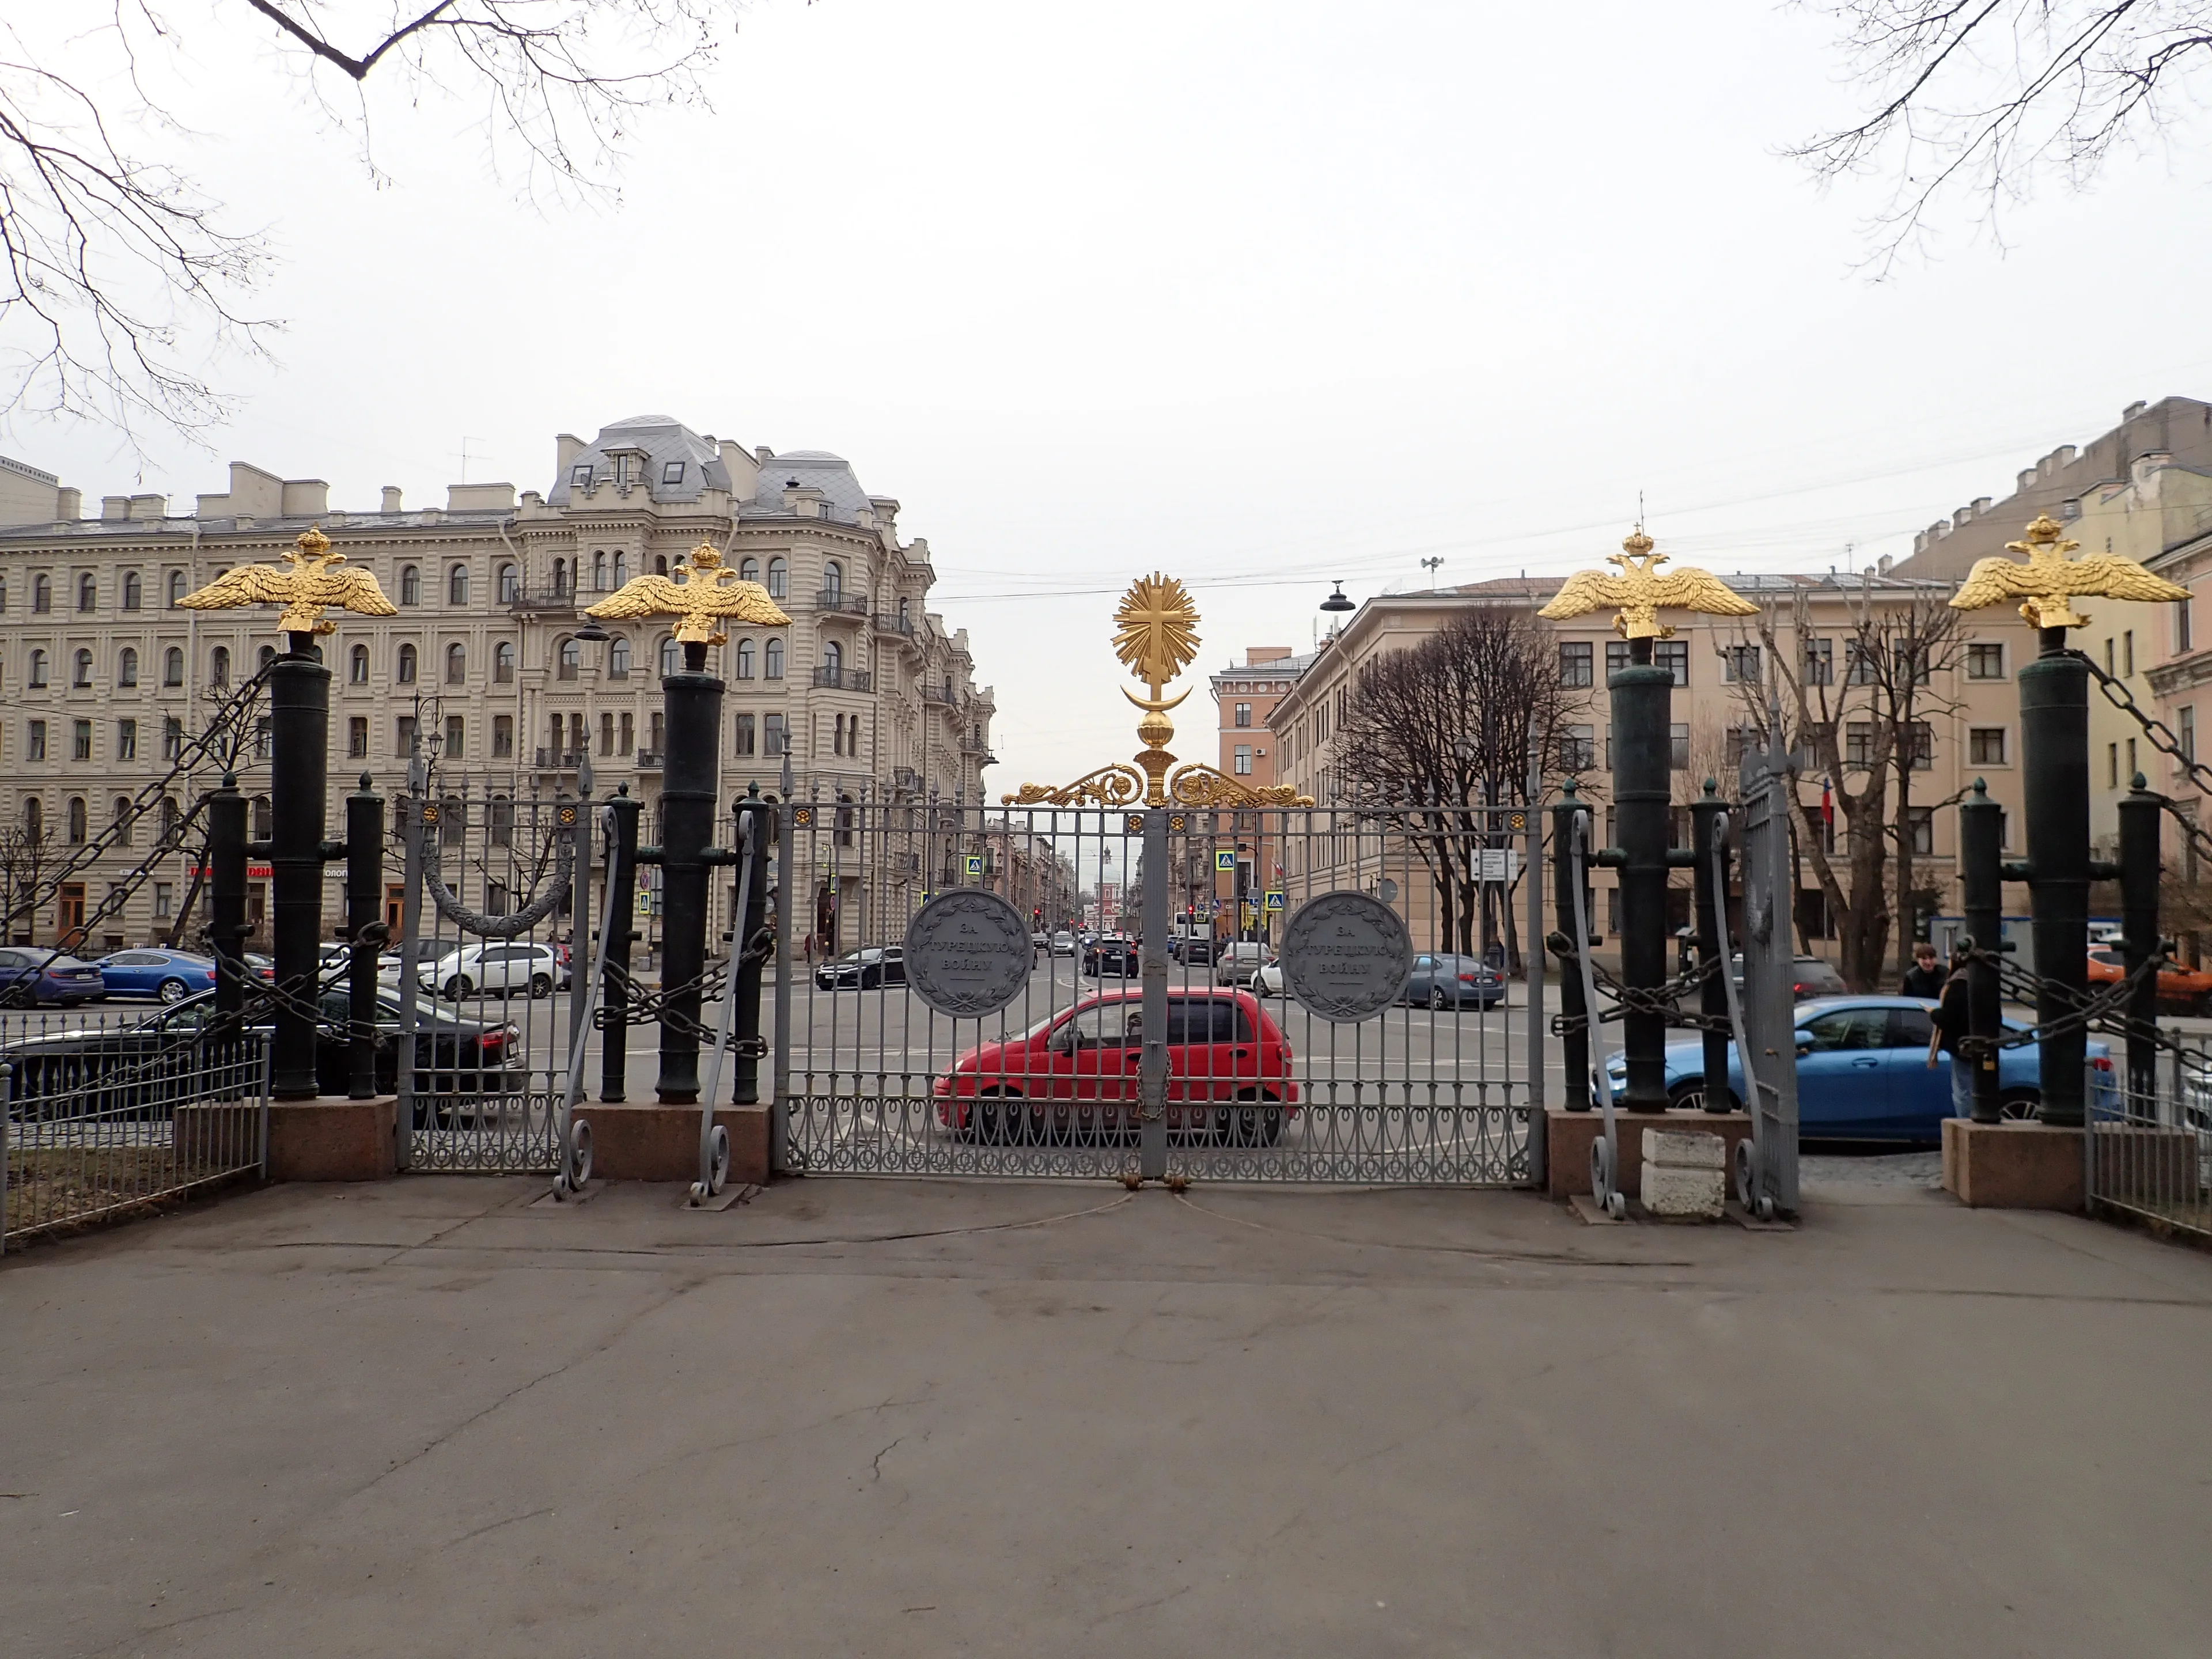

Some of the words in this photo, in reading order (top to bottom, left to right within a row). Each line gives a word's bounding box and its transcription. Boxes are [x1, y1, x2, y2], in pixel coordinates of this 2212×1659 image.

[959, 923, 979, 934] ЗА
[1336, 926, 1355, 937] ЗА
[929, 941, 1009, 954] ТУРЕЦКУЮ
[1305, 945, 1388, 957] ТУРЕЦКУЮ
[941, 958, 993, 971] ВОЙНУ
[1319, 962, 1371, 975] ВОЙНУ
